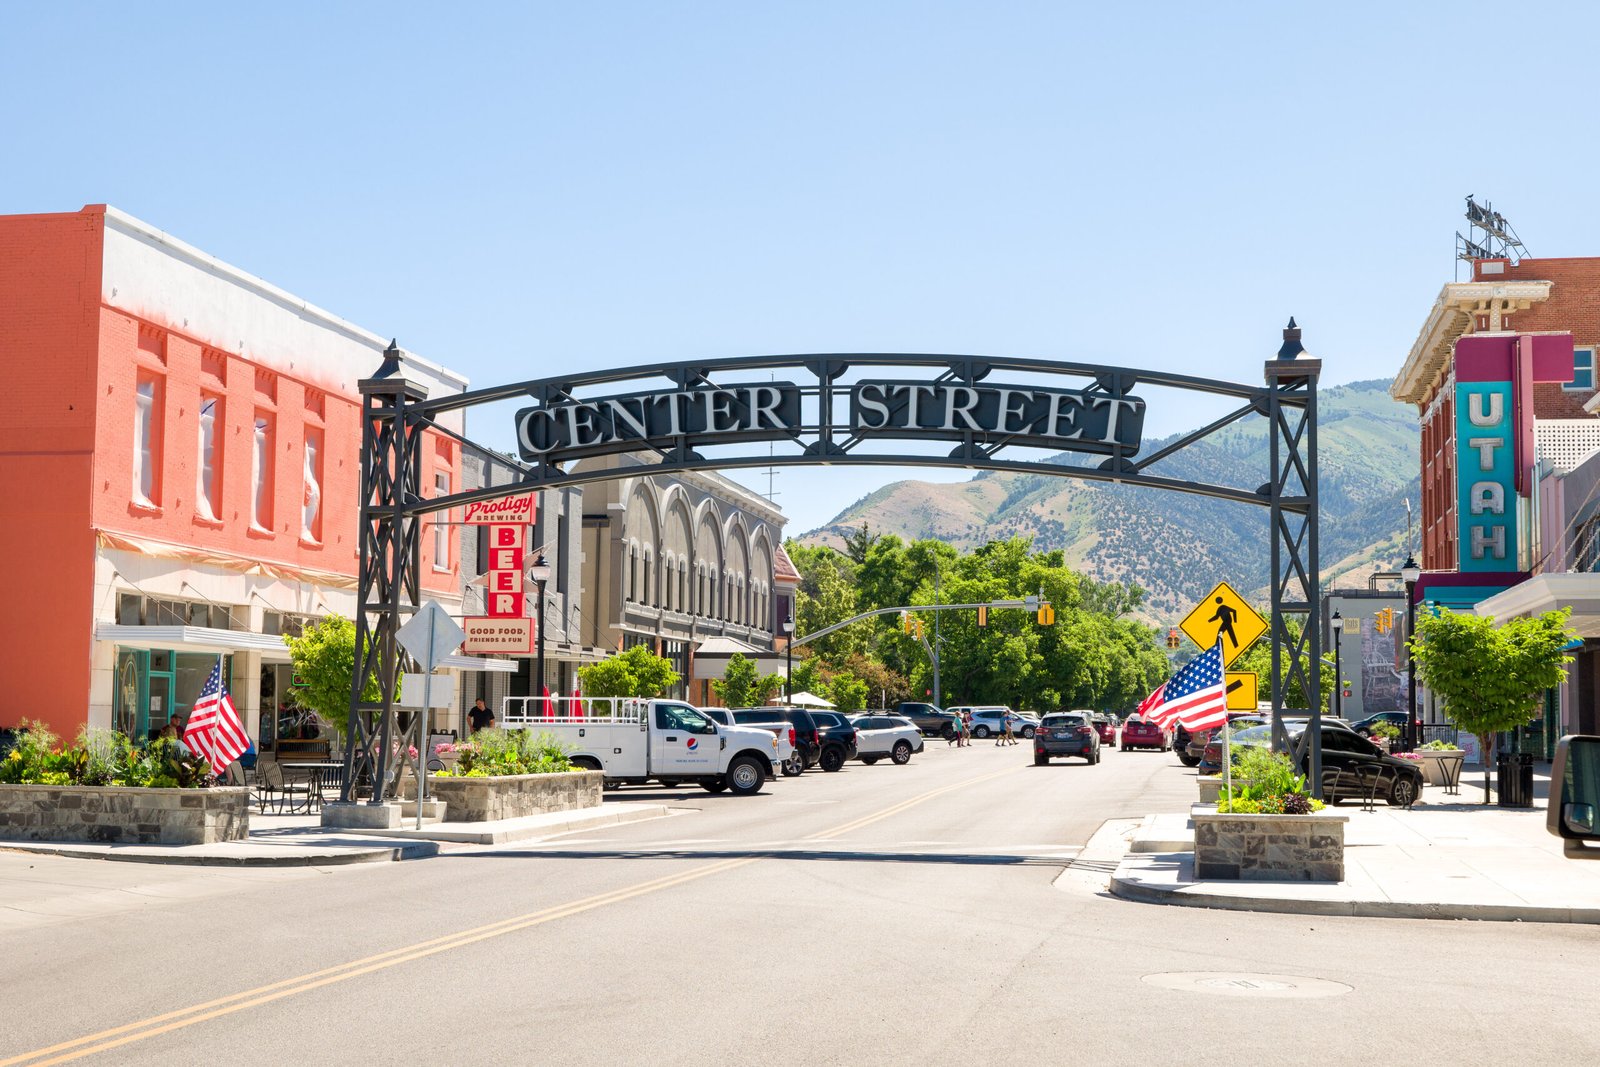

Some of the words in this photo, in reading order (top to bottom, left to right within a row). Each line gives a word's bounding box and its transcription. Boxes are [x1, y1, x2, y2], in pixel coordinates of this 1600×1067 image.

[518, 386, 789, 454] CENTER
[857, 383, 1138, 445] STREET
[465, 496, 532, 521] Prodigy
[1469, 393, 1506, 559] UTAH
[496, 527, 516, 614] BEER
[498, 628, 526, 636] FOOD,
